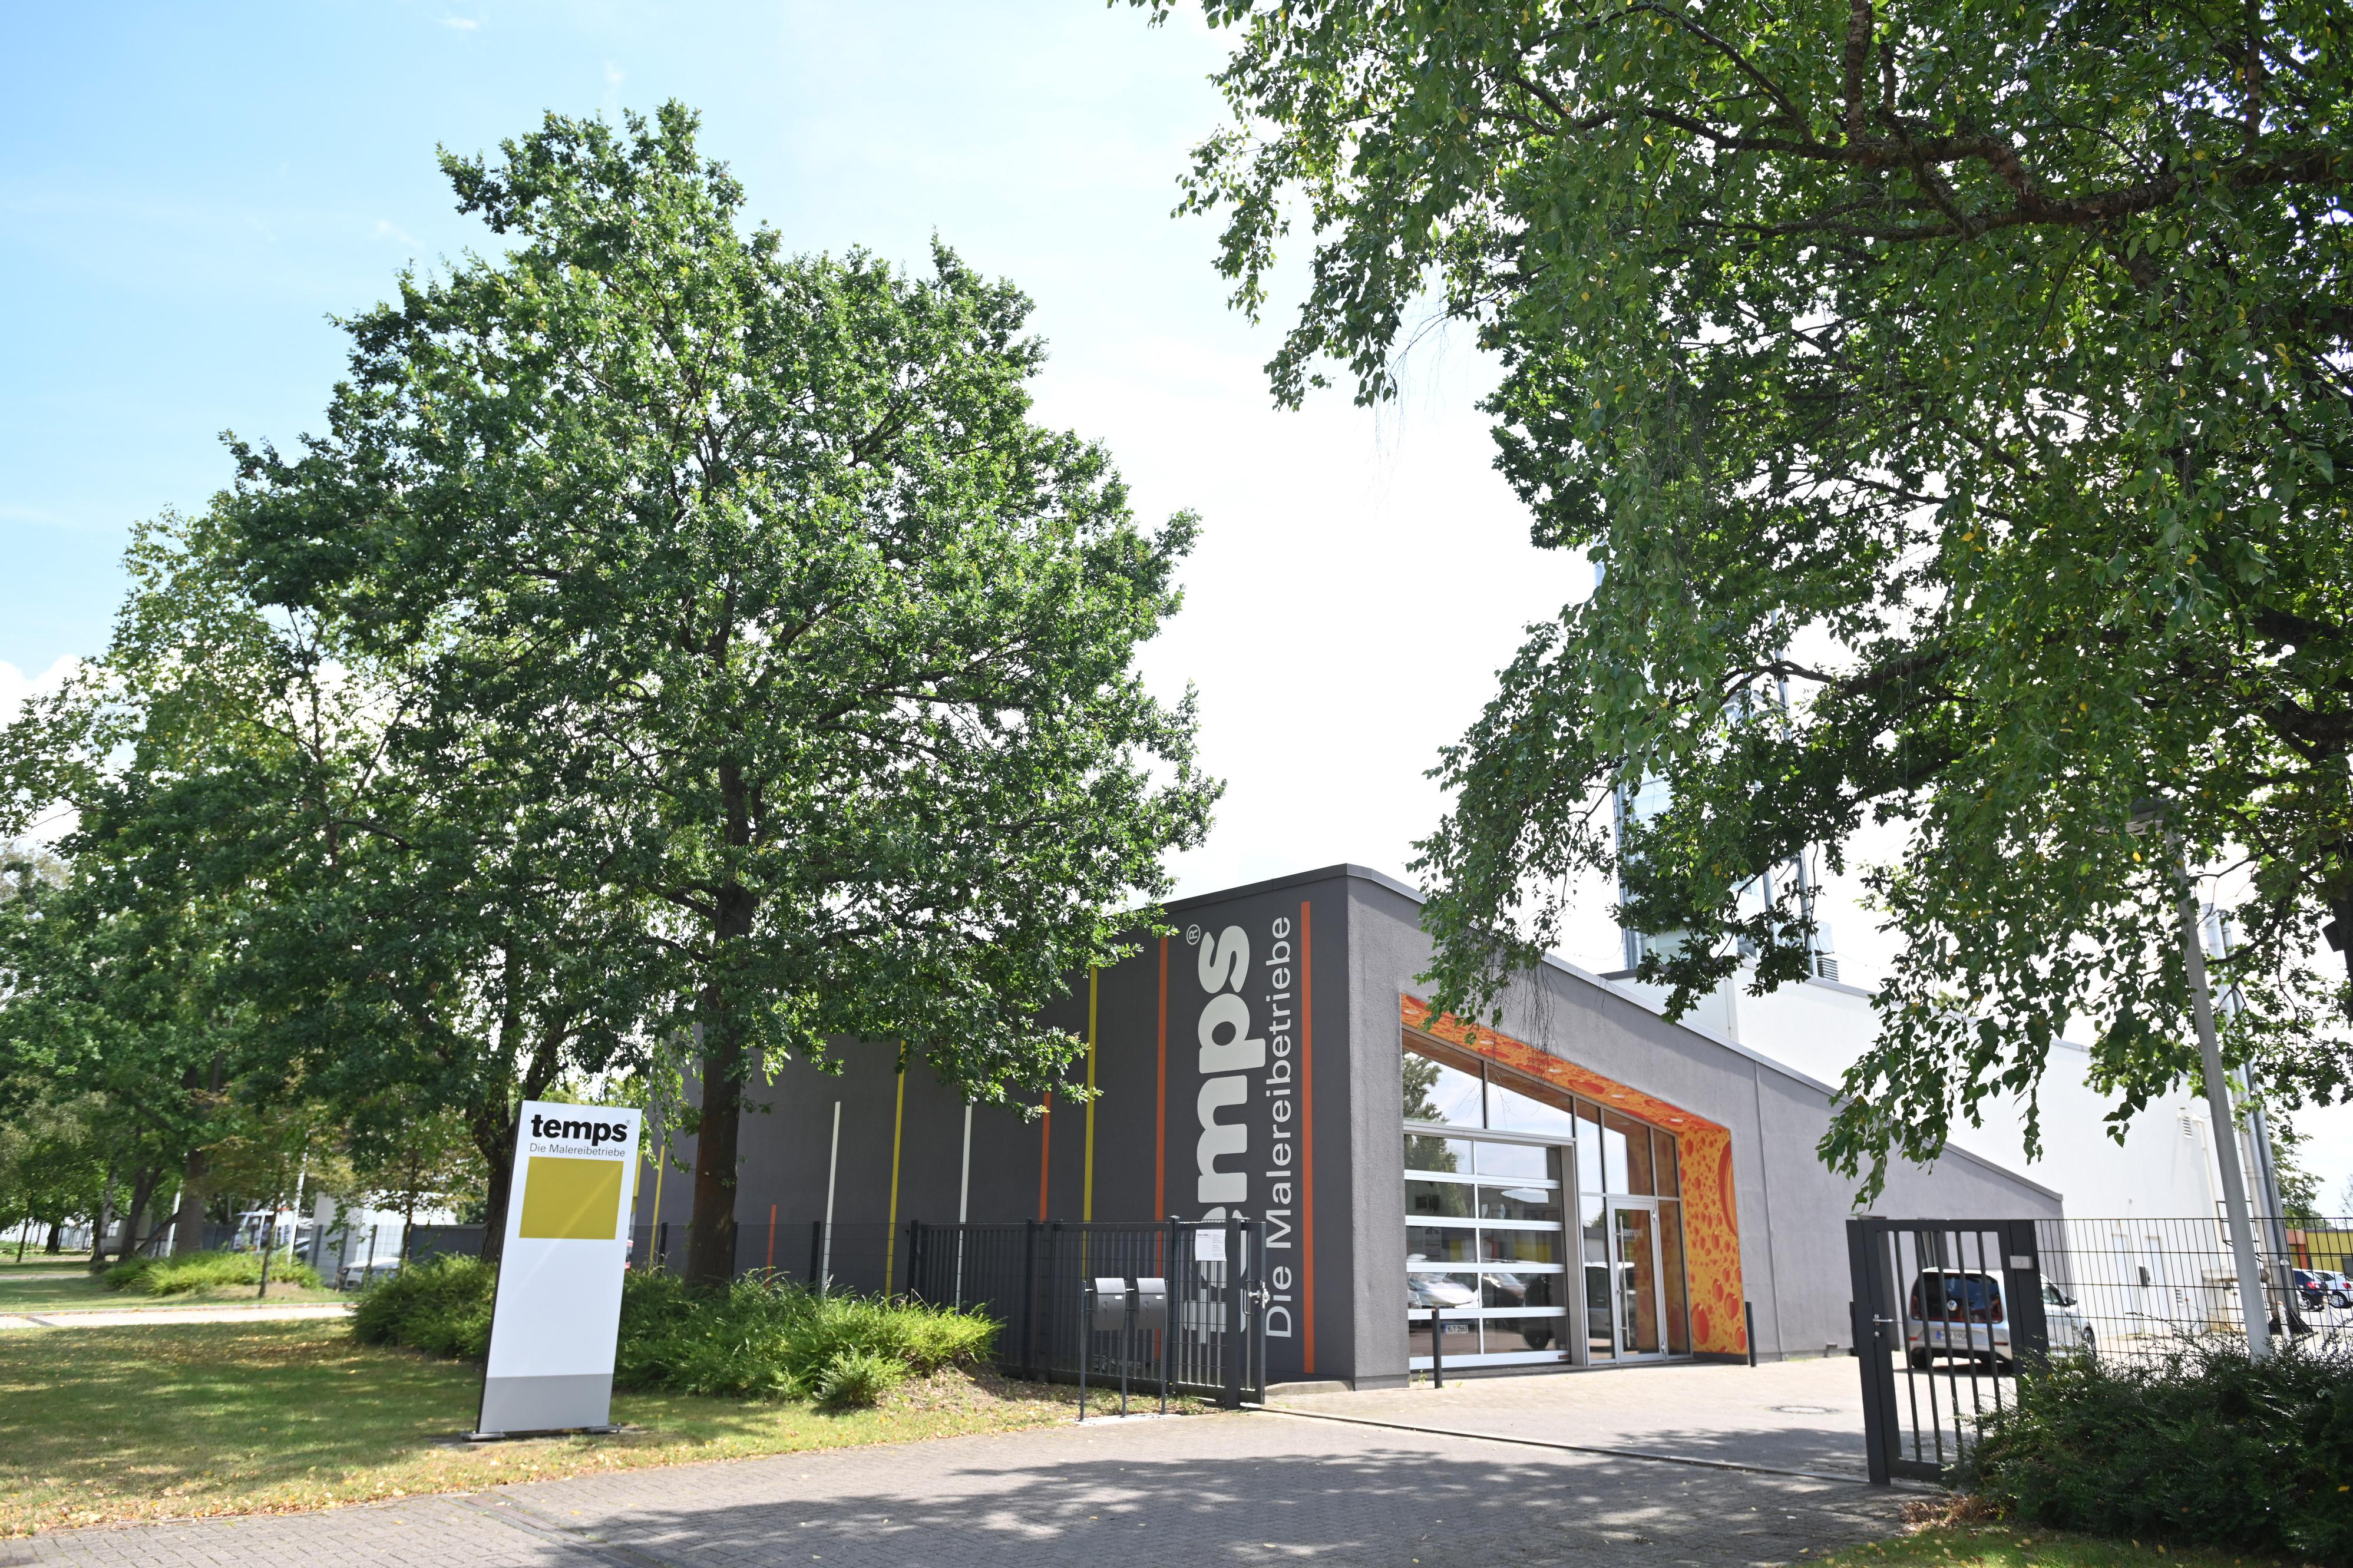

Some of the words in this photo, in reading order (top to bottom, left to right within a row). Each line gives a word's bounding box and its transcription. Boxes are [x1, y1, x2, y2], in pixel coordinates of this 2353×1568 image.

[1265, 917, 1292, 1249] Malereibetriebe
[531, 1114, 628, 1146] temps
[530, 1143, 546, 1153] Die
[549, 1144, 625, 1157] Malereibetriebe
[1622, 1228, 1643, 1239] emps
[1265, 1266, 1291, 1338] Die
